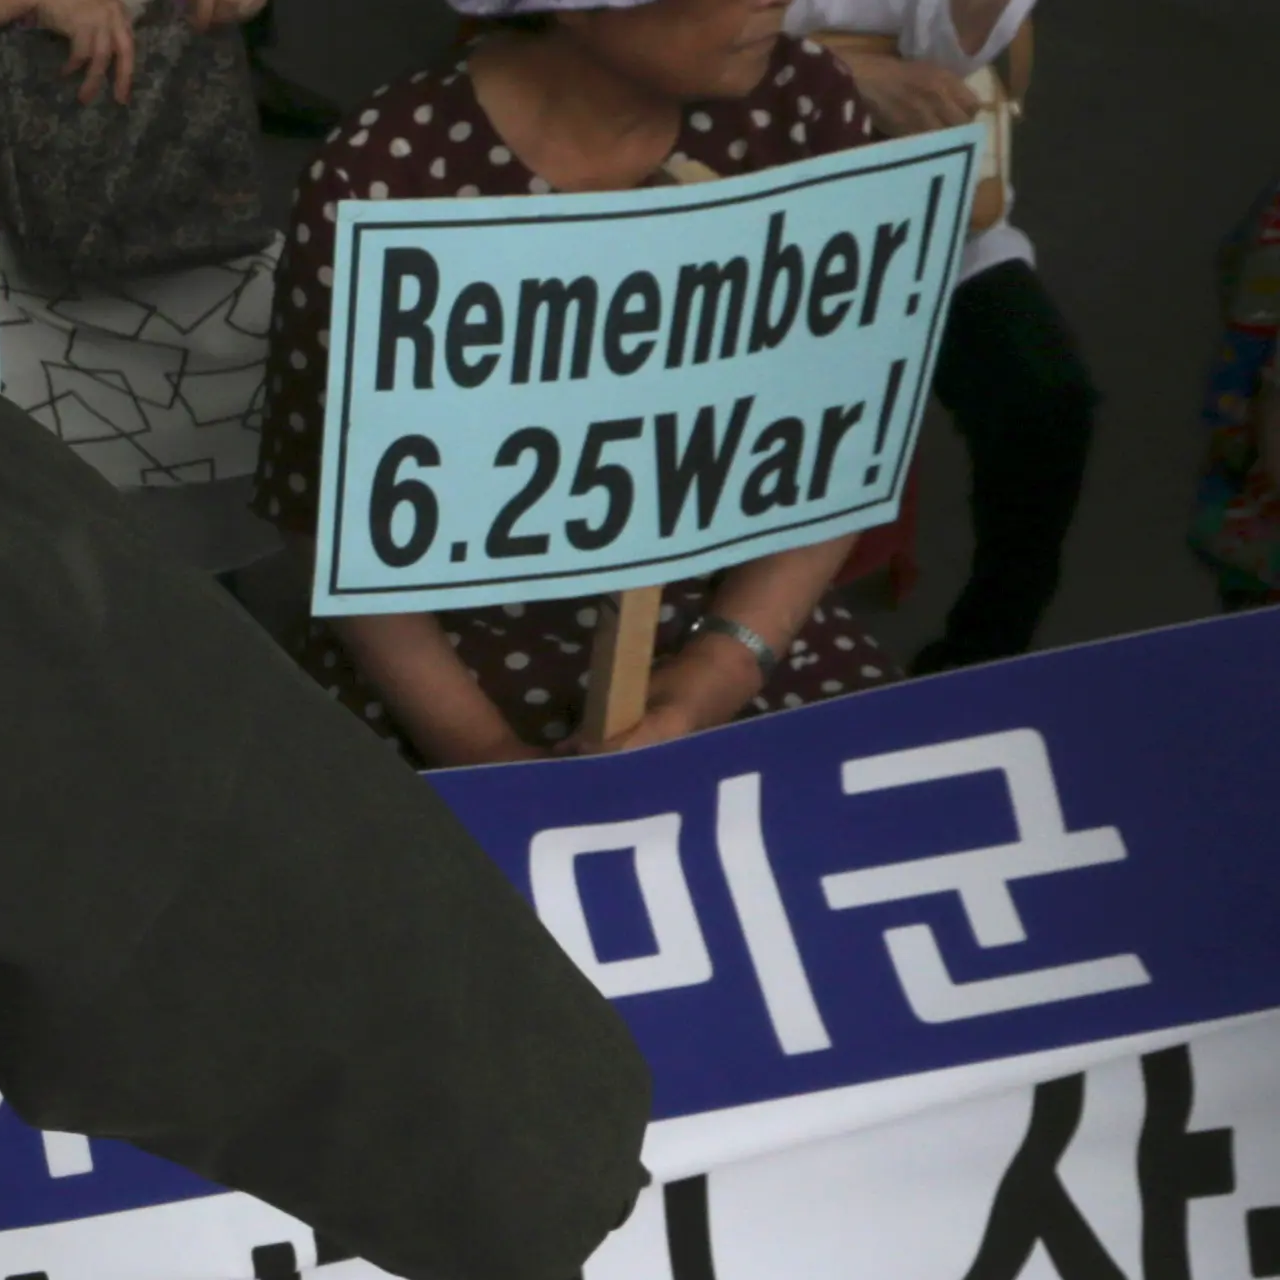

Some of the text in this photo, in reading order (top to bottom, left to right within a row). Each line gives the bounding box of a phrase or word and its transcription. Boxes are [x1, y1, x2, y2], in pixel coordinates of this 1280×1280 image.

[374, 174, 945, 391] Remember!
[368, 359, 907, 569] 6.25War!
[527, 728, 1153, 1056] 미군
